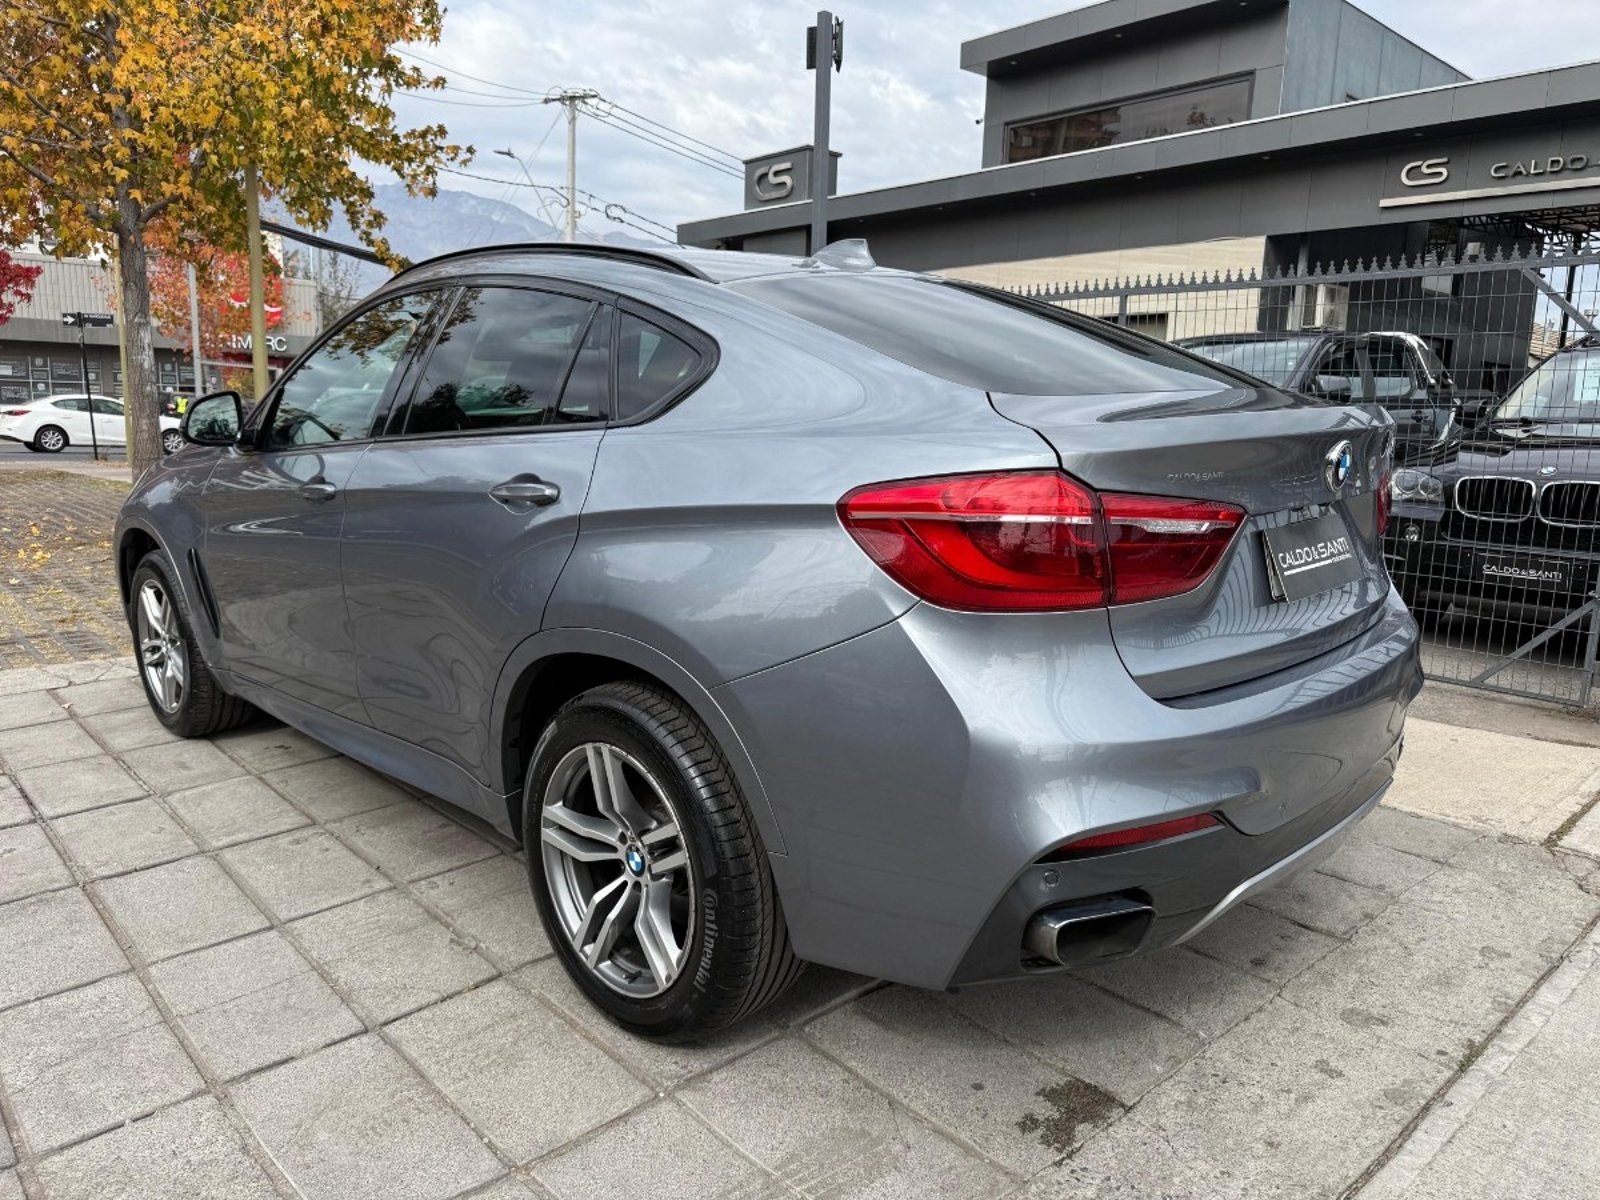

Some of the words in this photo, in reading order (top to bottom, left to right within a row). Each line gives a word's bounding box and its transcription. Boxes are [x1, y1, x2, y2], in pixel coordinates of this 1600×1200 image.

[754, 162, 793, 201] CS
[1400, 157, 1448, 187] CS
[1490, 154, 1587, 177] CALDO
[1278, 536, 1349, 568] CALDO&SANTI
[693, 888, 719, 993] Continental
